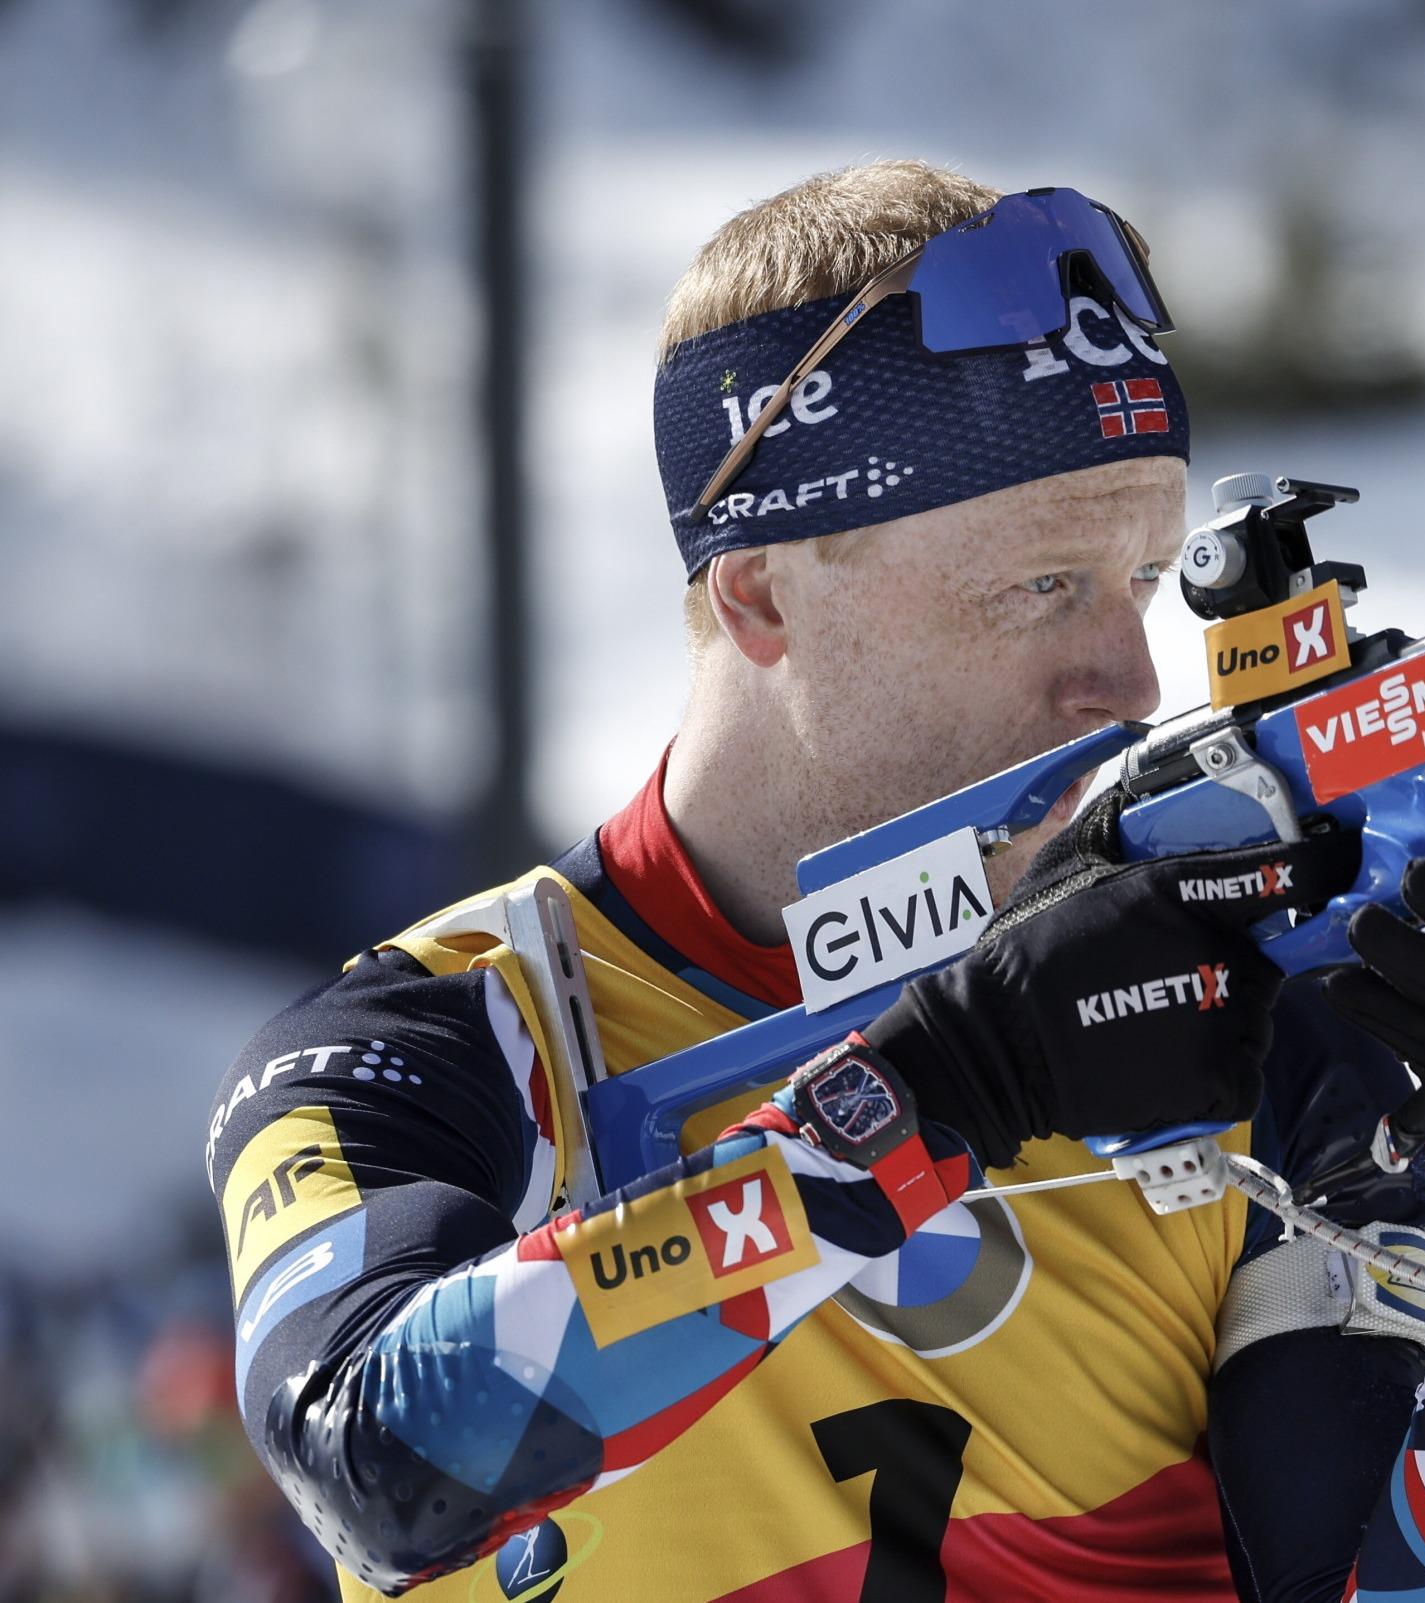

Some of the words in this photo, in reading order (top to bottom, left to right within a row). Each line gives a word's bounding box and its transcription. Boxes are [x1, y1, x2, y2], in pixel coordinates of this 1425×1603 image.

[707, 469, 859, 525] CRAFT
[1193, 545, 1211, 568] G
[1217, 644, 1280, 677] Uno
[1292, 605, 1328, 667] X
[1178, 861, 1294, 902] KINETIXX
[1076, 963, 1230, 1028] KINETIXX
[590, 1235, 691, 1291] Uno
[707, 1178, 778, 1269] X
[809, 1397, 973, 1603] 1
